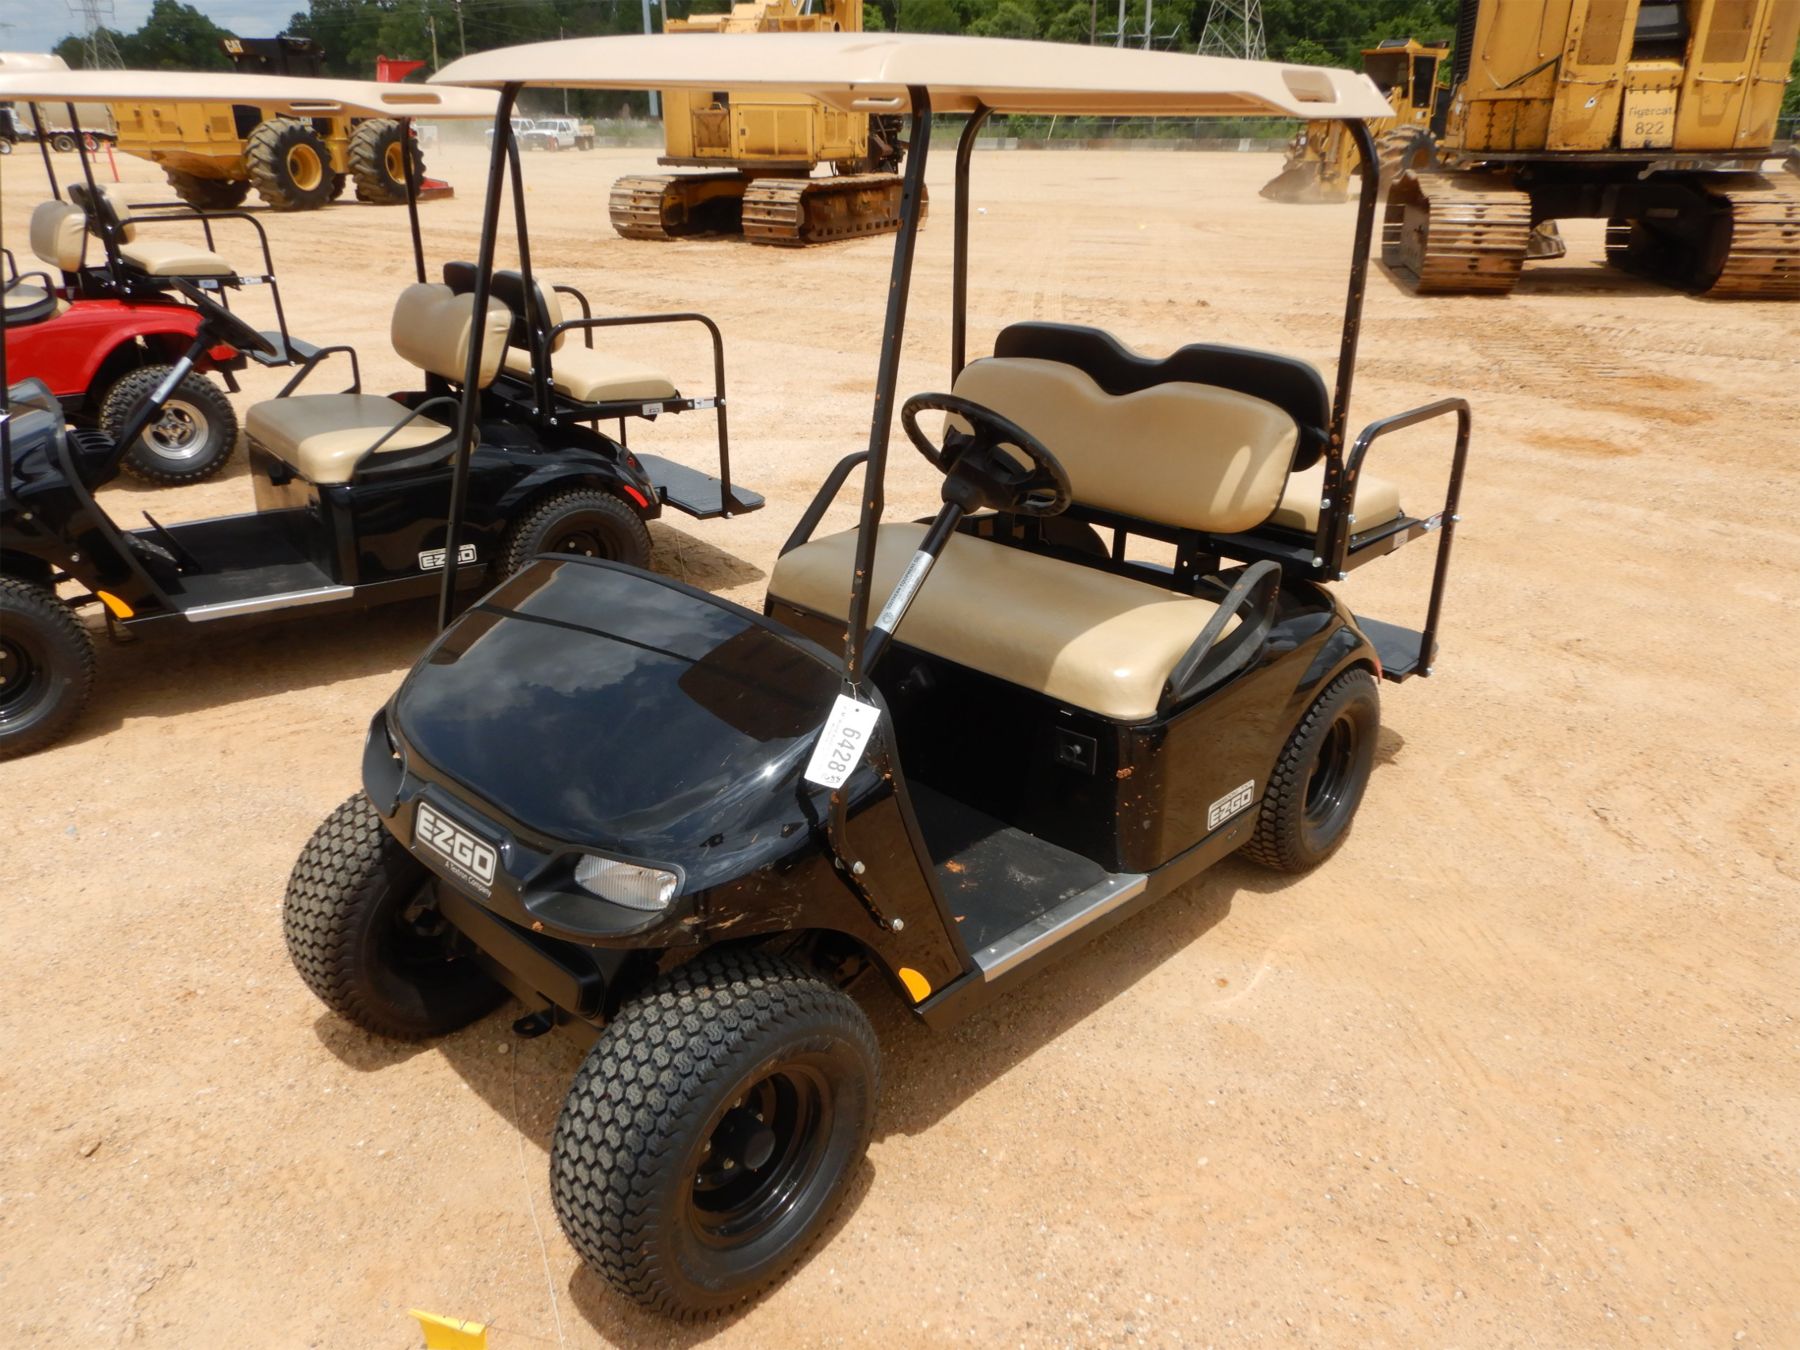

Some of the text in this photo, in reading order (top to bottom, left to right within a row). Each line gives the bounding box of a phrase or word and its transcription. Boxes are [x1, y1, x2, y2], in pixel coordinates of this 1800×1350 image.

[1635, 121, 1664, 135] 822
[422, 549, 475, 568] EZO
[828, 727, 861, 772] 6428
[467, 876, 493, 898] Company
